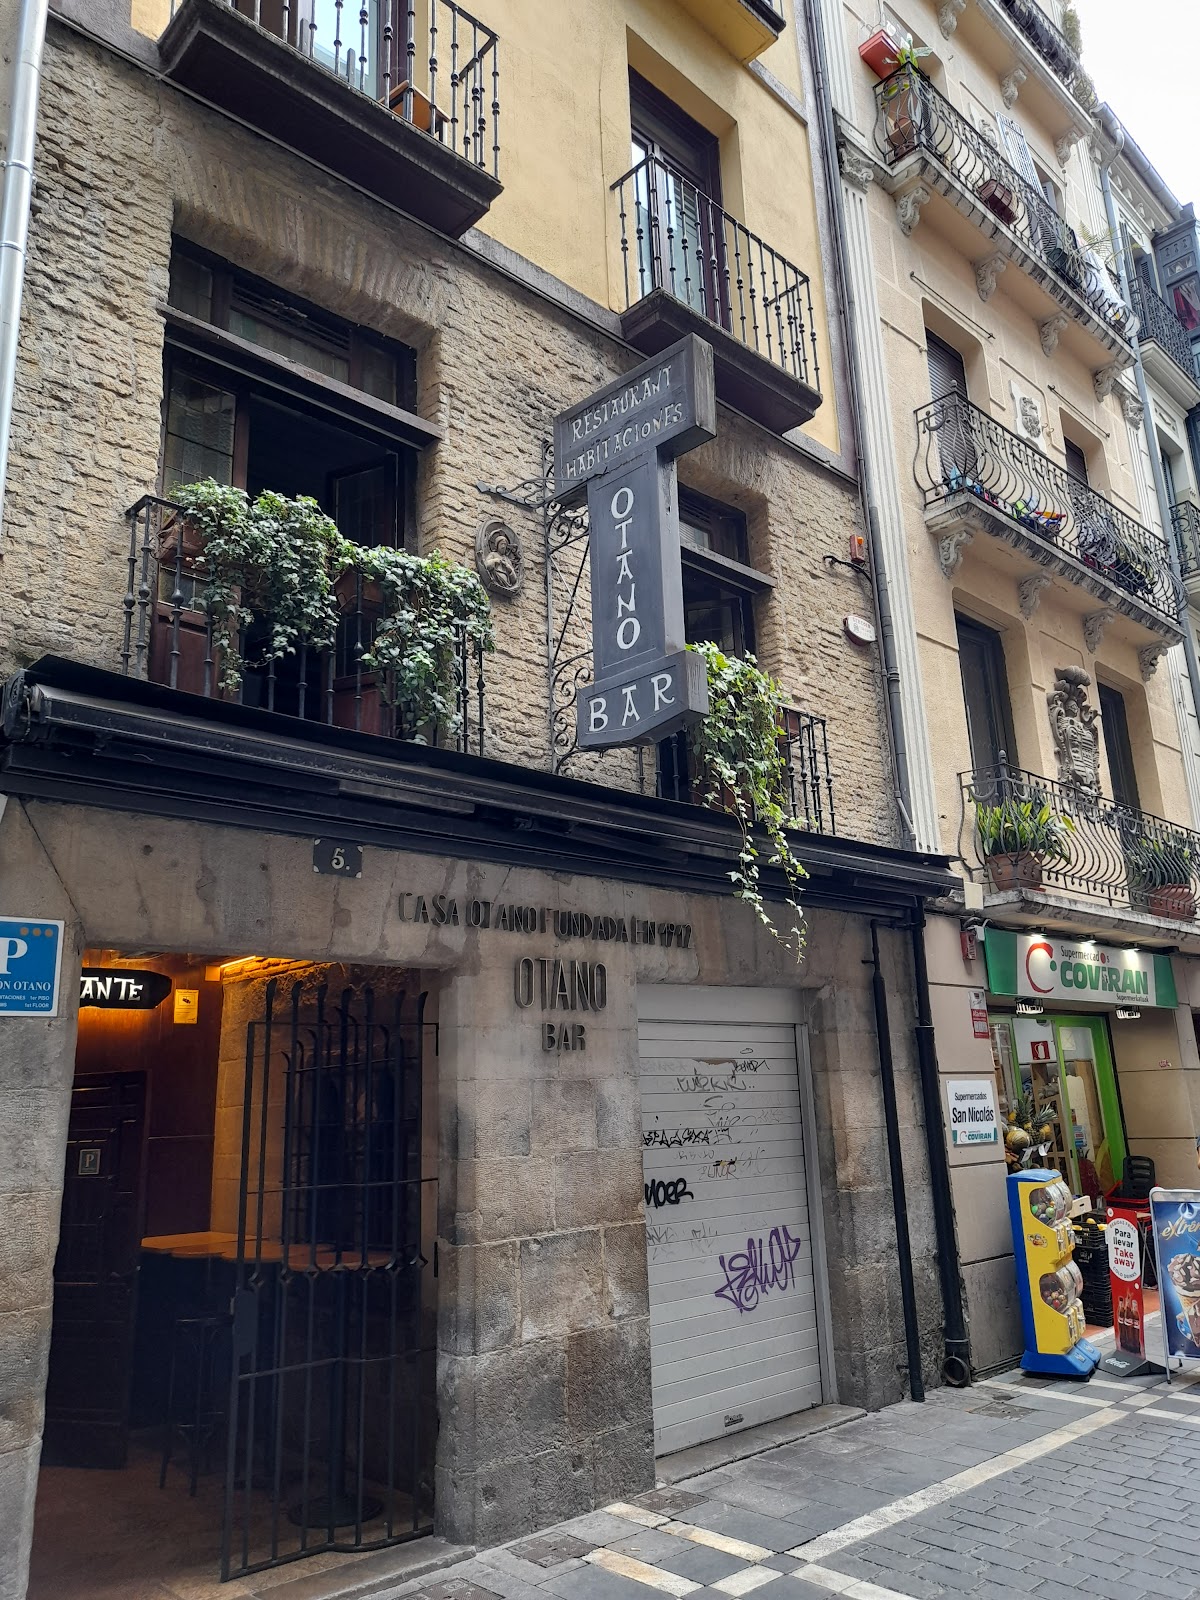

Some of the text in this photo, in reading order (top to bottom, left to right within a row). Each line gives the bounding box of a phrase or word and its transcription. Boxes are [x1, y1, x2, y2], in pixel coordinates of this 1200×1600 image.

[571, 365, 672, 443] RESTAURANT
[566, 402, 683, 479] HABITACIONES
[610, 487, 641, 650] OTANO
[588, 672, 675, 732] BAR
[399, 892, 460, 926] CASA
[466, 899, 537, 933] OTANO
[540, 906, 628, 942] FUNDADA
[631, 916, 656, 945] EN
[13, 980, 51, 992] OTANO
[514, 956, 608, 1012] OTANO
[1060, 960, 1149, 995] COVIRAN
[541, 1022, 586, 1051] BAR
[954, 1091, 988, 1102] Supermercados
[952, 1105, 994, 1124] San Nicolás
[967, 1132, 992, 1141] COVIRAN
[1113, 1236, 1134, 1249] llevar
[1114, 1228, 1131, 1239] Para
[1114, 1247, 1134, 1259] Take
[1114, 1257, 1135, 1270] away
